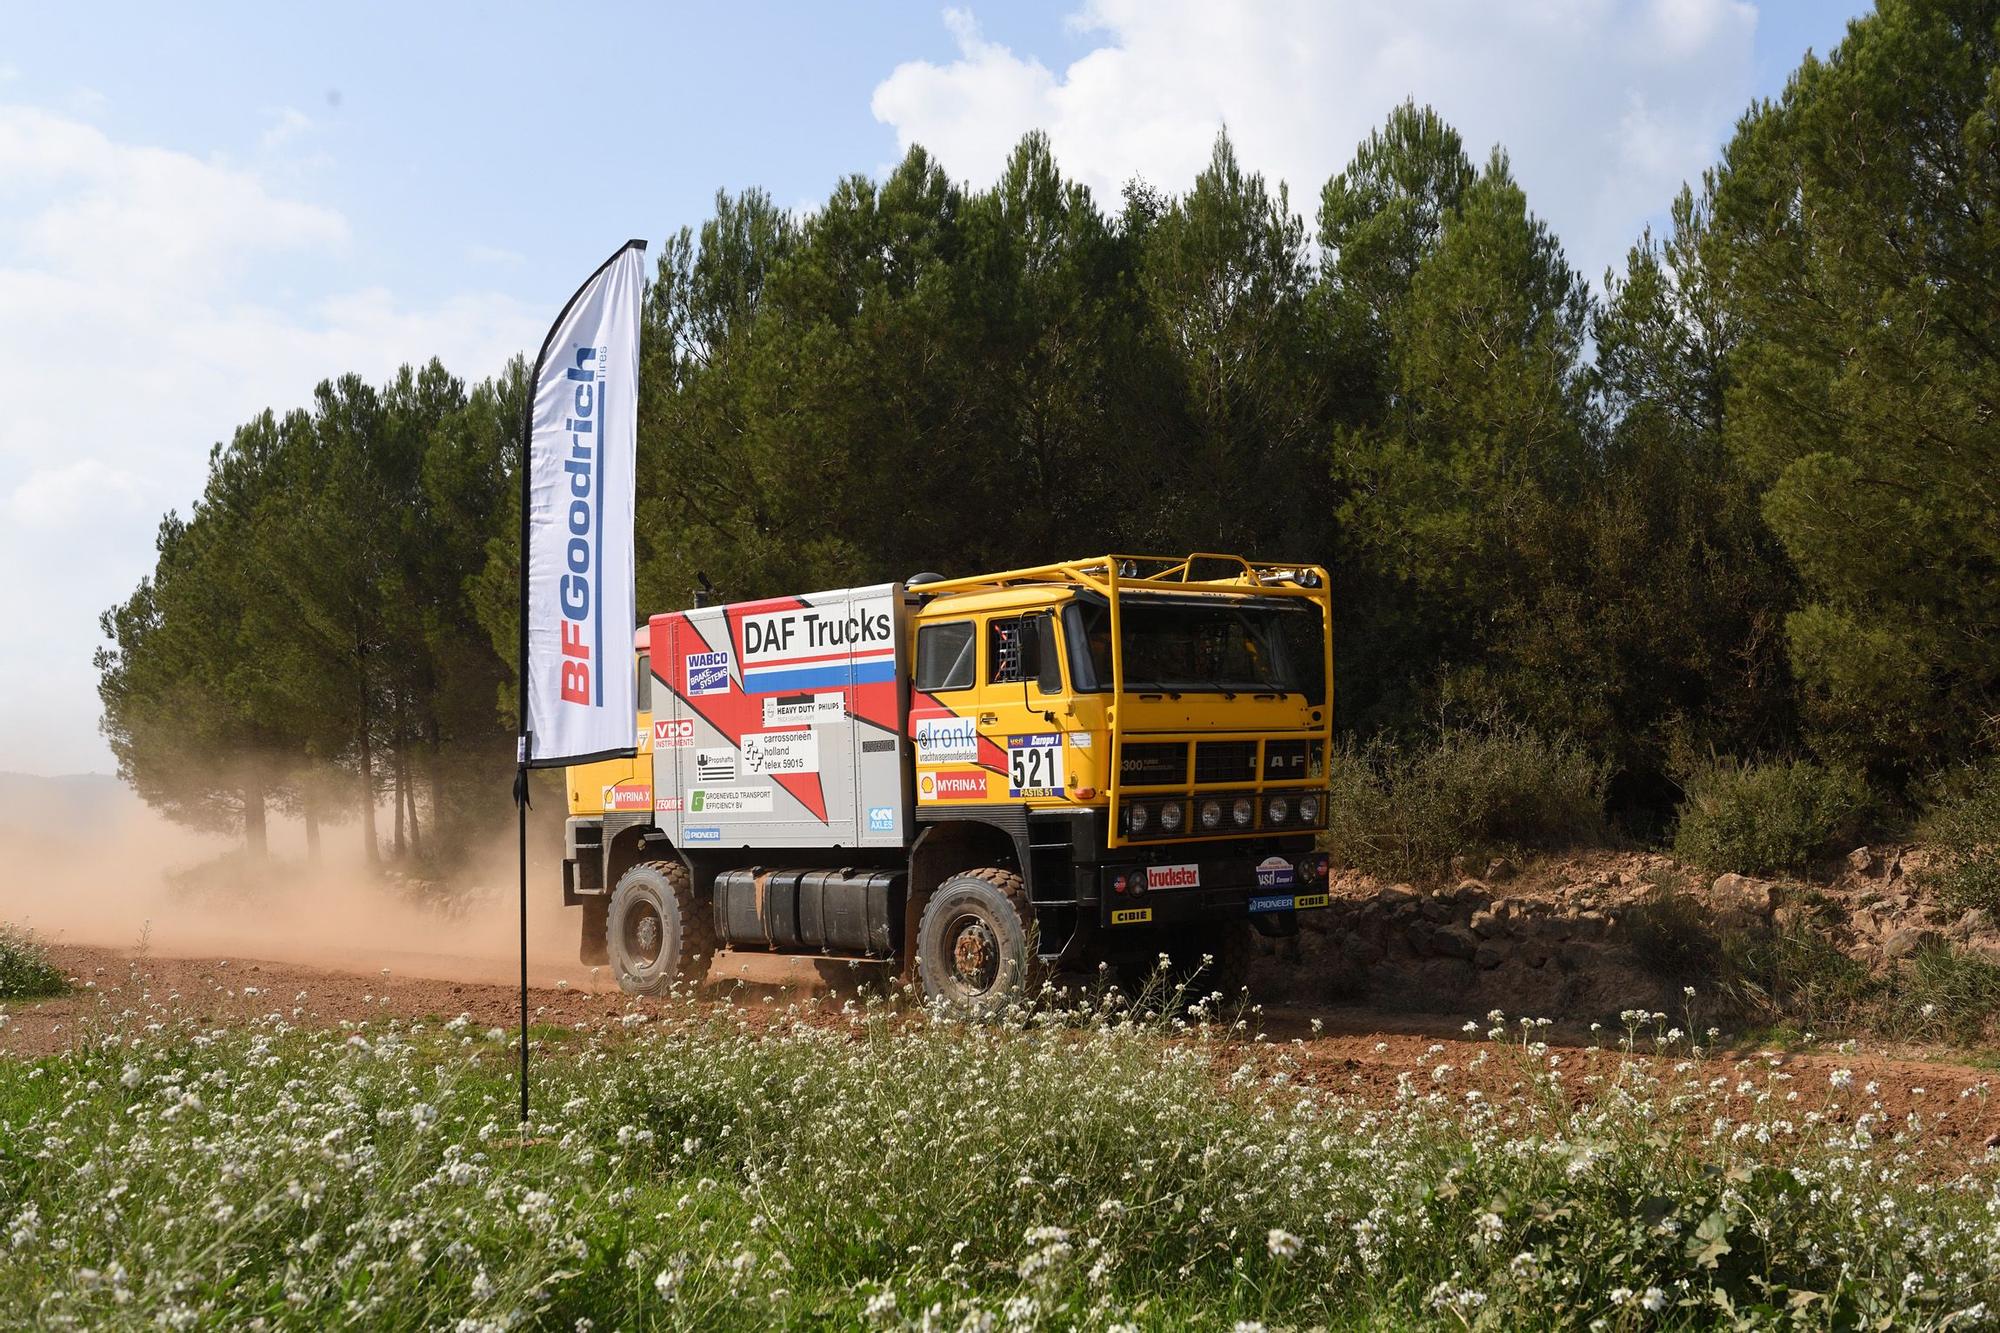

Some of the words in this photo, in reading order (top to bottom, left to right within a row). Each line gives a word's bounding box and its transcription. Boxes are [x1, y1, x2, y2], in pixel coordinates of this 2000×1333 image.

[596, 345, 607, 378] Tires
[560, 347, 596, 705] BFGoodrich
[745, 617, 795, 654] DAF
[803, 608, 891, 647] Trucks
[688, 652, 728, 667] WABCO
[690, 668, 712, 686] BRAKE-
[700, 667, 728, 689] SYSTEMS
[777, 706, 797, 715] HEAVY
[798, 704, 815, 714] DUTY
[818, 702, 839, 710] PHILIPS
[655, 721, 693, 738] VDO
[655, 738, 693, 748] INSTRUMENTS
[1031, 735, 1054, 748] Europe
[764, 746, 789, 756] holland
[708, 756, 733, 764] Propshafts
[764, 760, 781, 769] telex
[783, 758, 803, 768] 59015
[1120, 760, 1143, 771] 300
[1012, 748, 1055, 788] 521
[937, 779, 977, 792] MYRINA
[979, 779, 986, 791] X
[615, 792, 643, 802] MYRINA
[645, 791, 650, 801] X
[1020, 788, 1044, 797] PASTIS
[1045, 788, 1053, 796] 51
[871, 820, 893, 830] AXLES
[690, 831, 719, 839] PIONEER
[1149, 867, 1197, 888] truckstar
[1257, 899, 1293, 909] PIONEER
[1300, 896, 1324, 906] CIBIE
[1117, 911, 1147, 922] CIBIE
